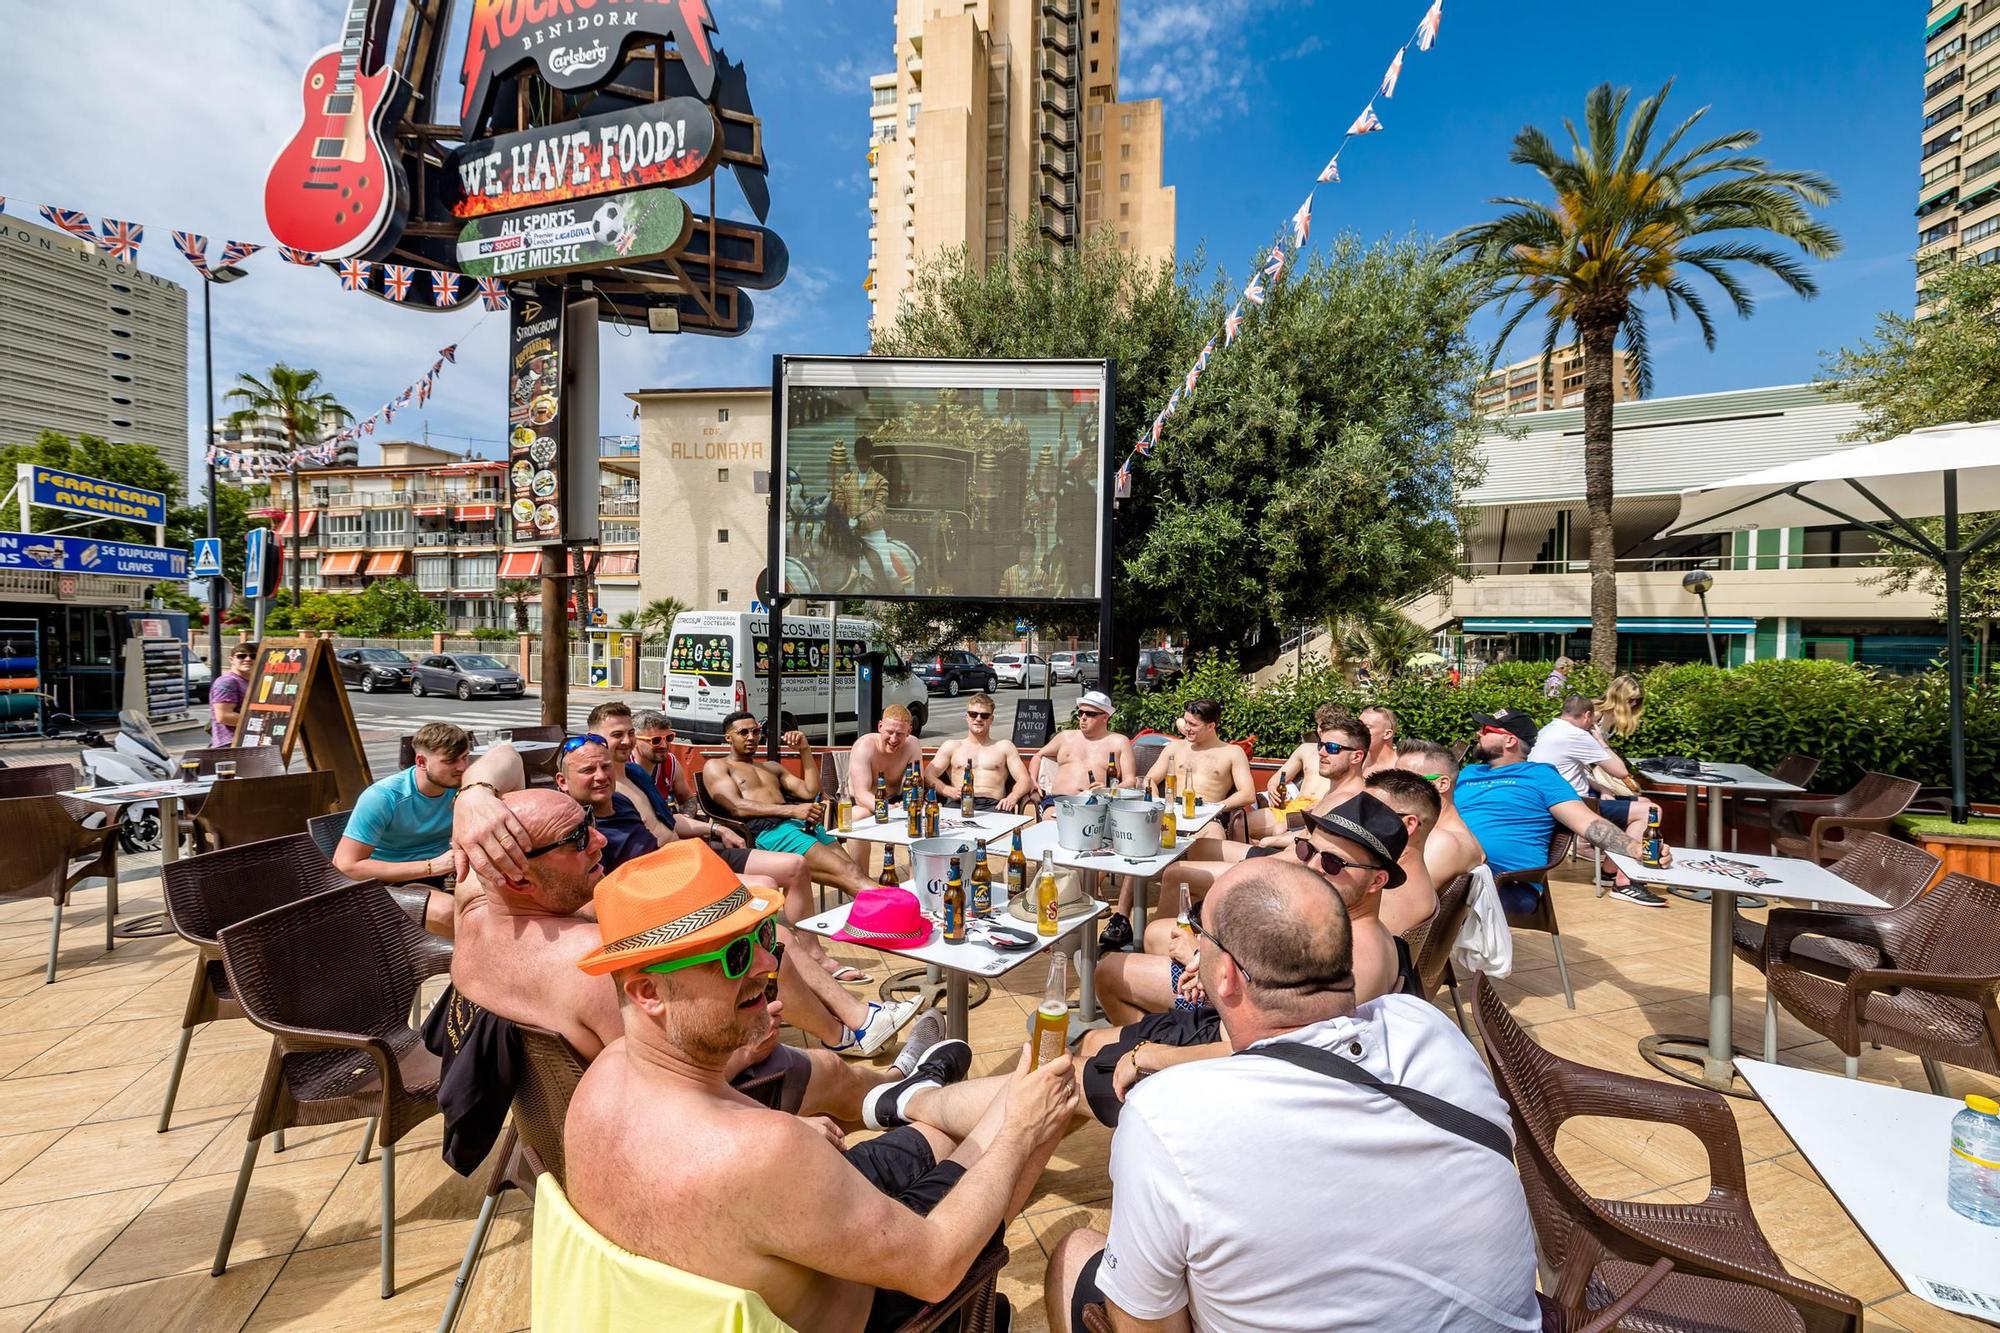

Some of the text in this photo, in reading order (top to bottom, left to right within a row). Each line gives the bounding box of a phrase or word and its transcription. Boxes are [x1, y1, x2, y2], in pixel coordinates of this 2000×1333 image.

[522, 12, 639, 50] BENIDORM
[549, 44, 608, 74] Carlsberg
[459, 119, 686, 196] WE HAVE FOOD!
[500, 209, 576, 236] ALL SPORTS
[480, 238, 520, 253] sky sports
[493, 244, 581, 274] LIVE MUSIC
[80, 252, 175, 291] BACANA
[516, 317, 558, 342] STRONGBOW
[671, 442, 763, 459] ALLONAYA
[38, 472, 160, 507] FERRETERIA
[55, 491, 148, 518] AVENIDA
[101, 546, 168, 561] SE DUPLICAN
[117, 561, 154, 573] LLAVES
[750, 619, 805, 637] CÍTCOS
